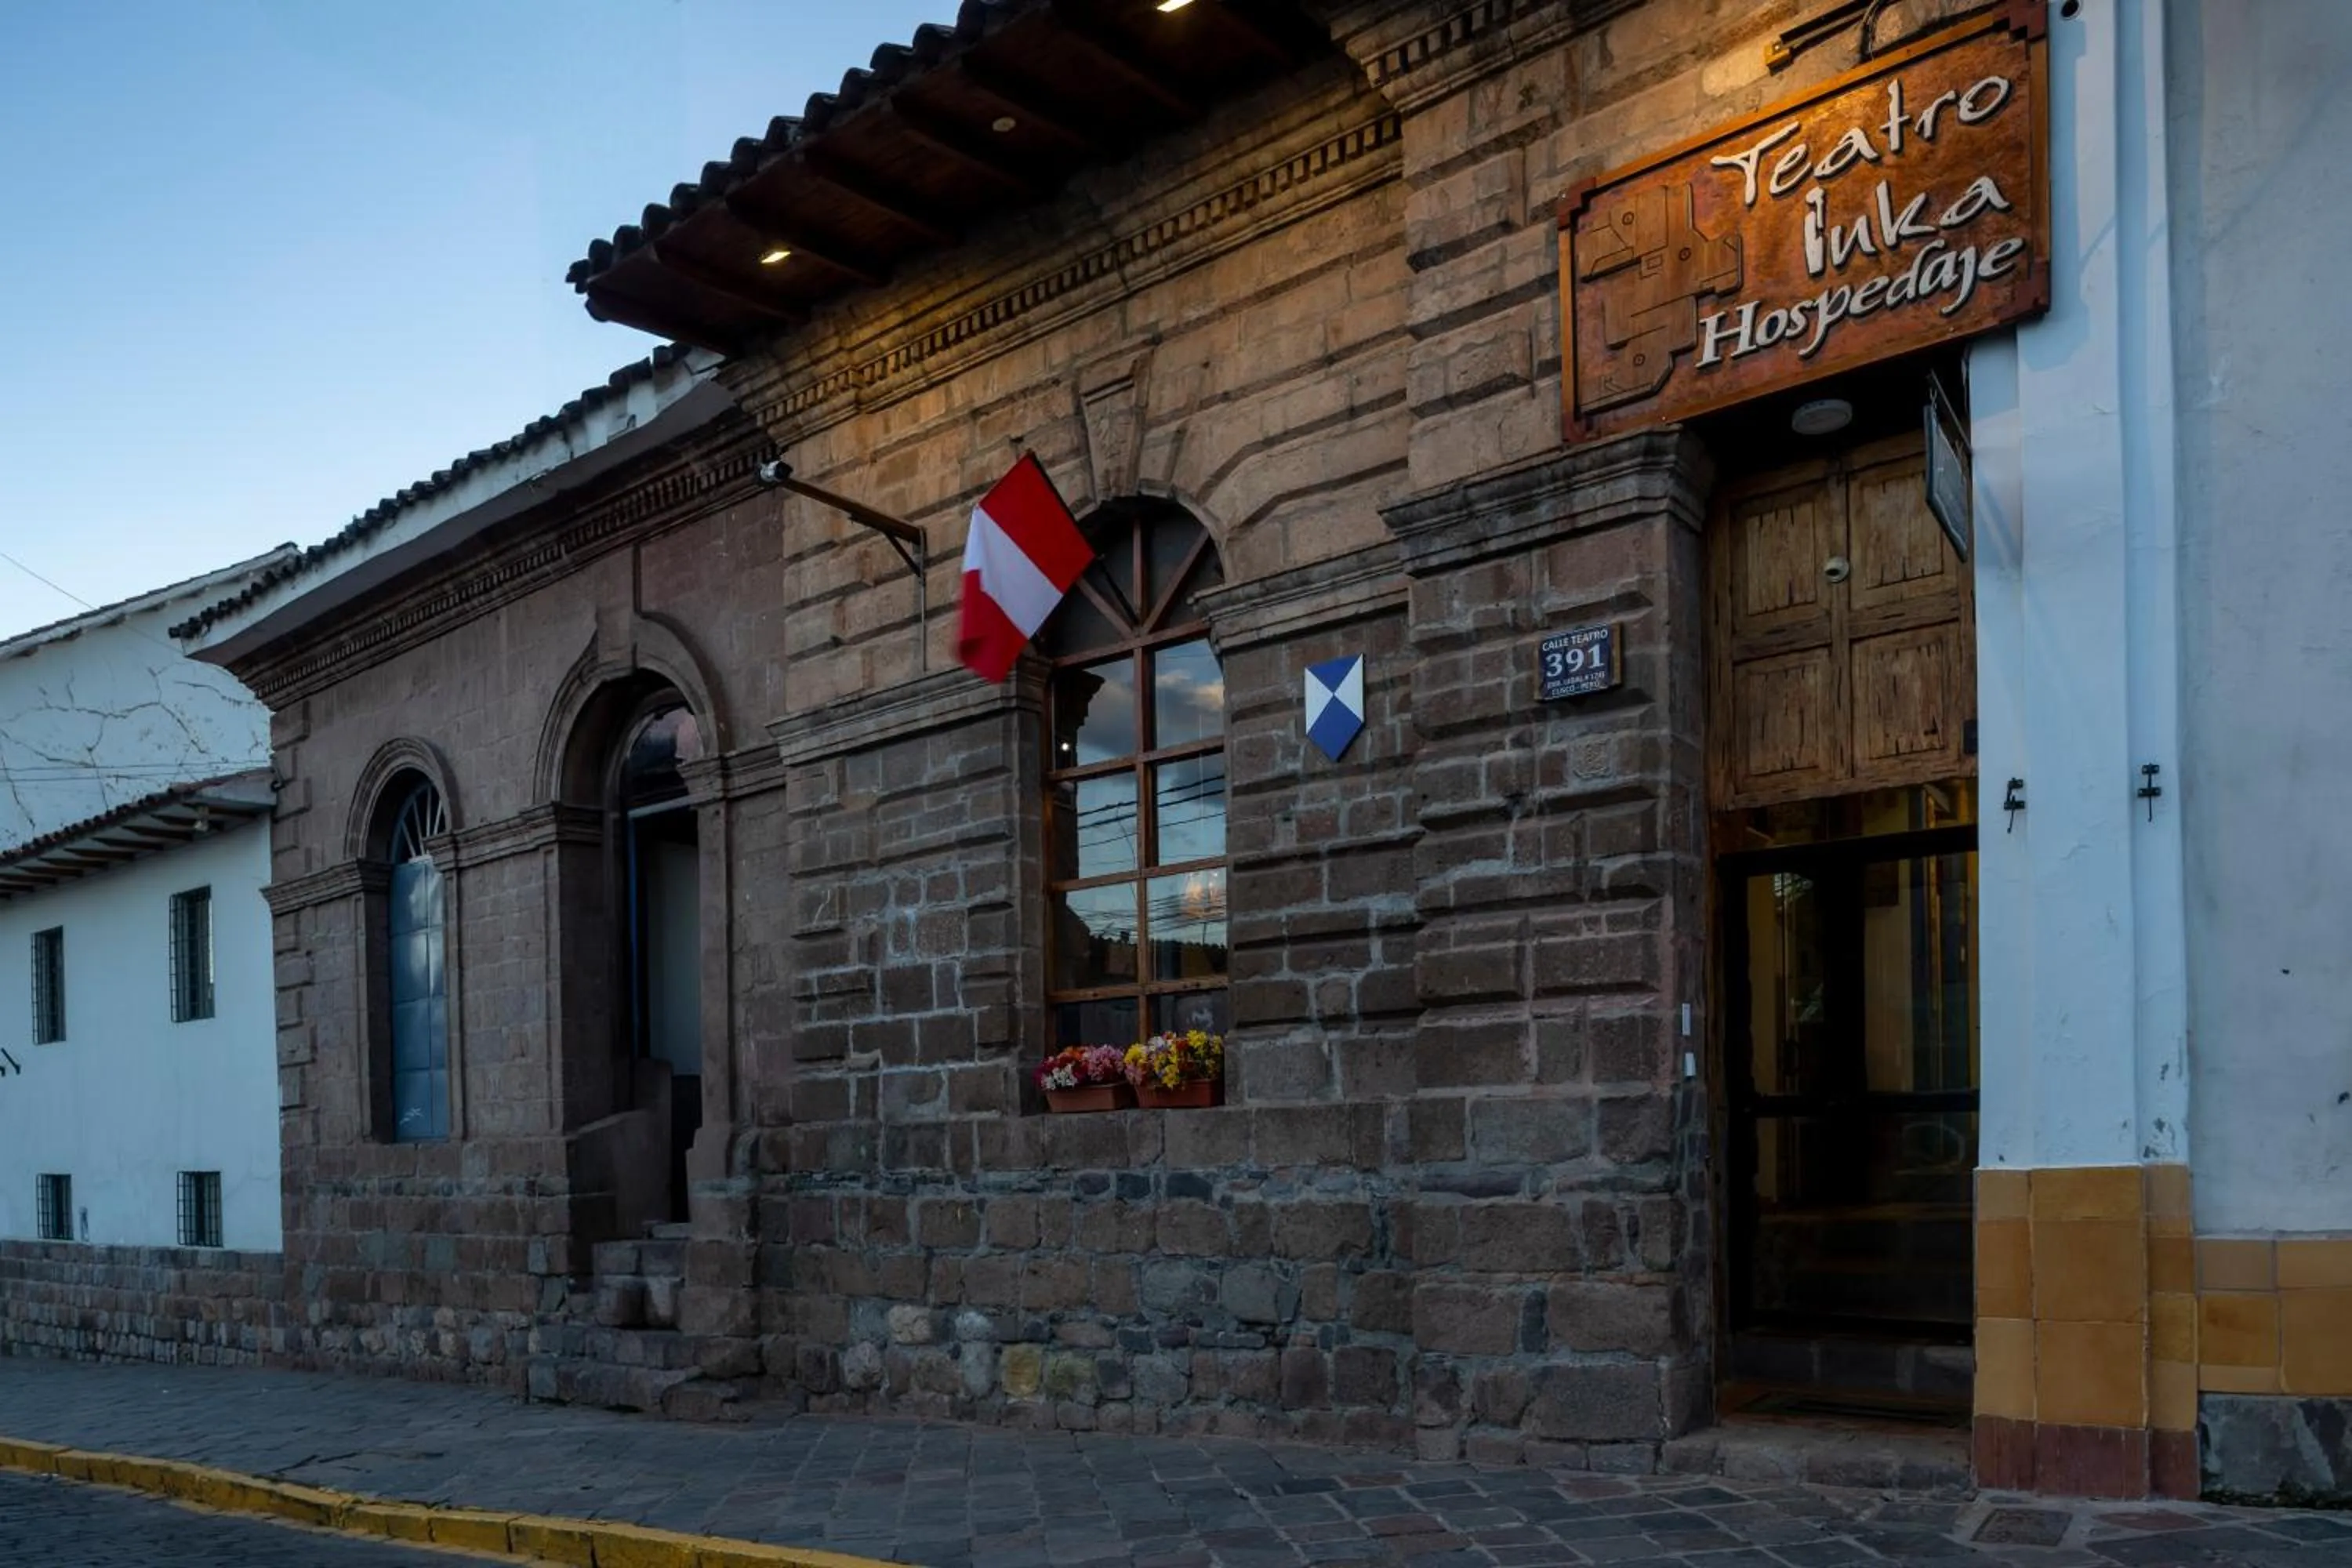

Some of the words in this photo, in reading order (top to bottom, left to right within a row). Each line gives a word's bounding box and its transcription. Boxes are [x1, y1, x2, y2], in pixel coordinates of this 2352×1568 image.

[1711, 76, 2009, 205] Teatro
[1695, 237, 2024, 368] Hospedaje
[1542, 637, 1570, 652] CALLE
[1571, 629, 1608, 644] TEATRO
[1544, 644, 1605, 677] 391
